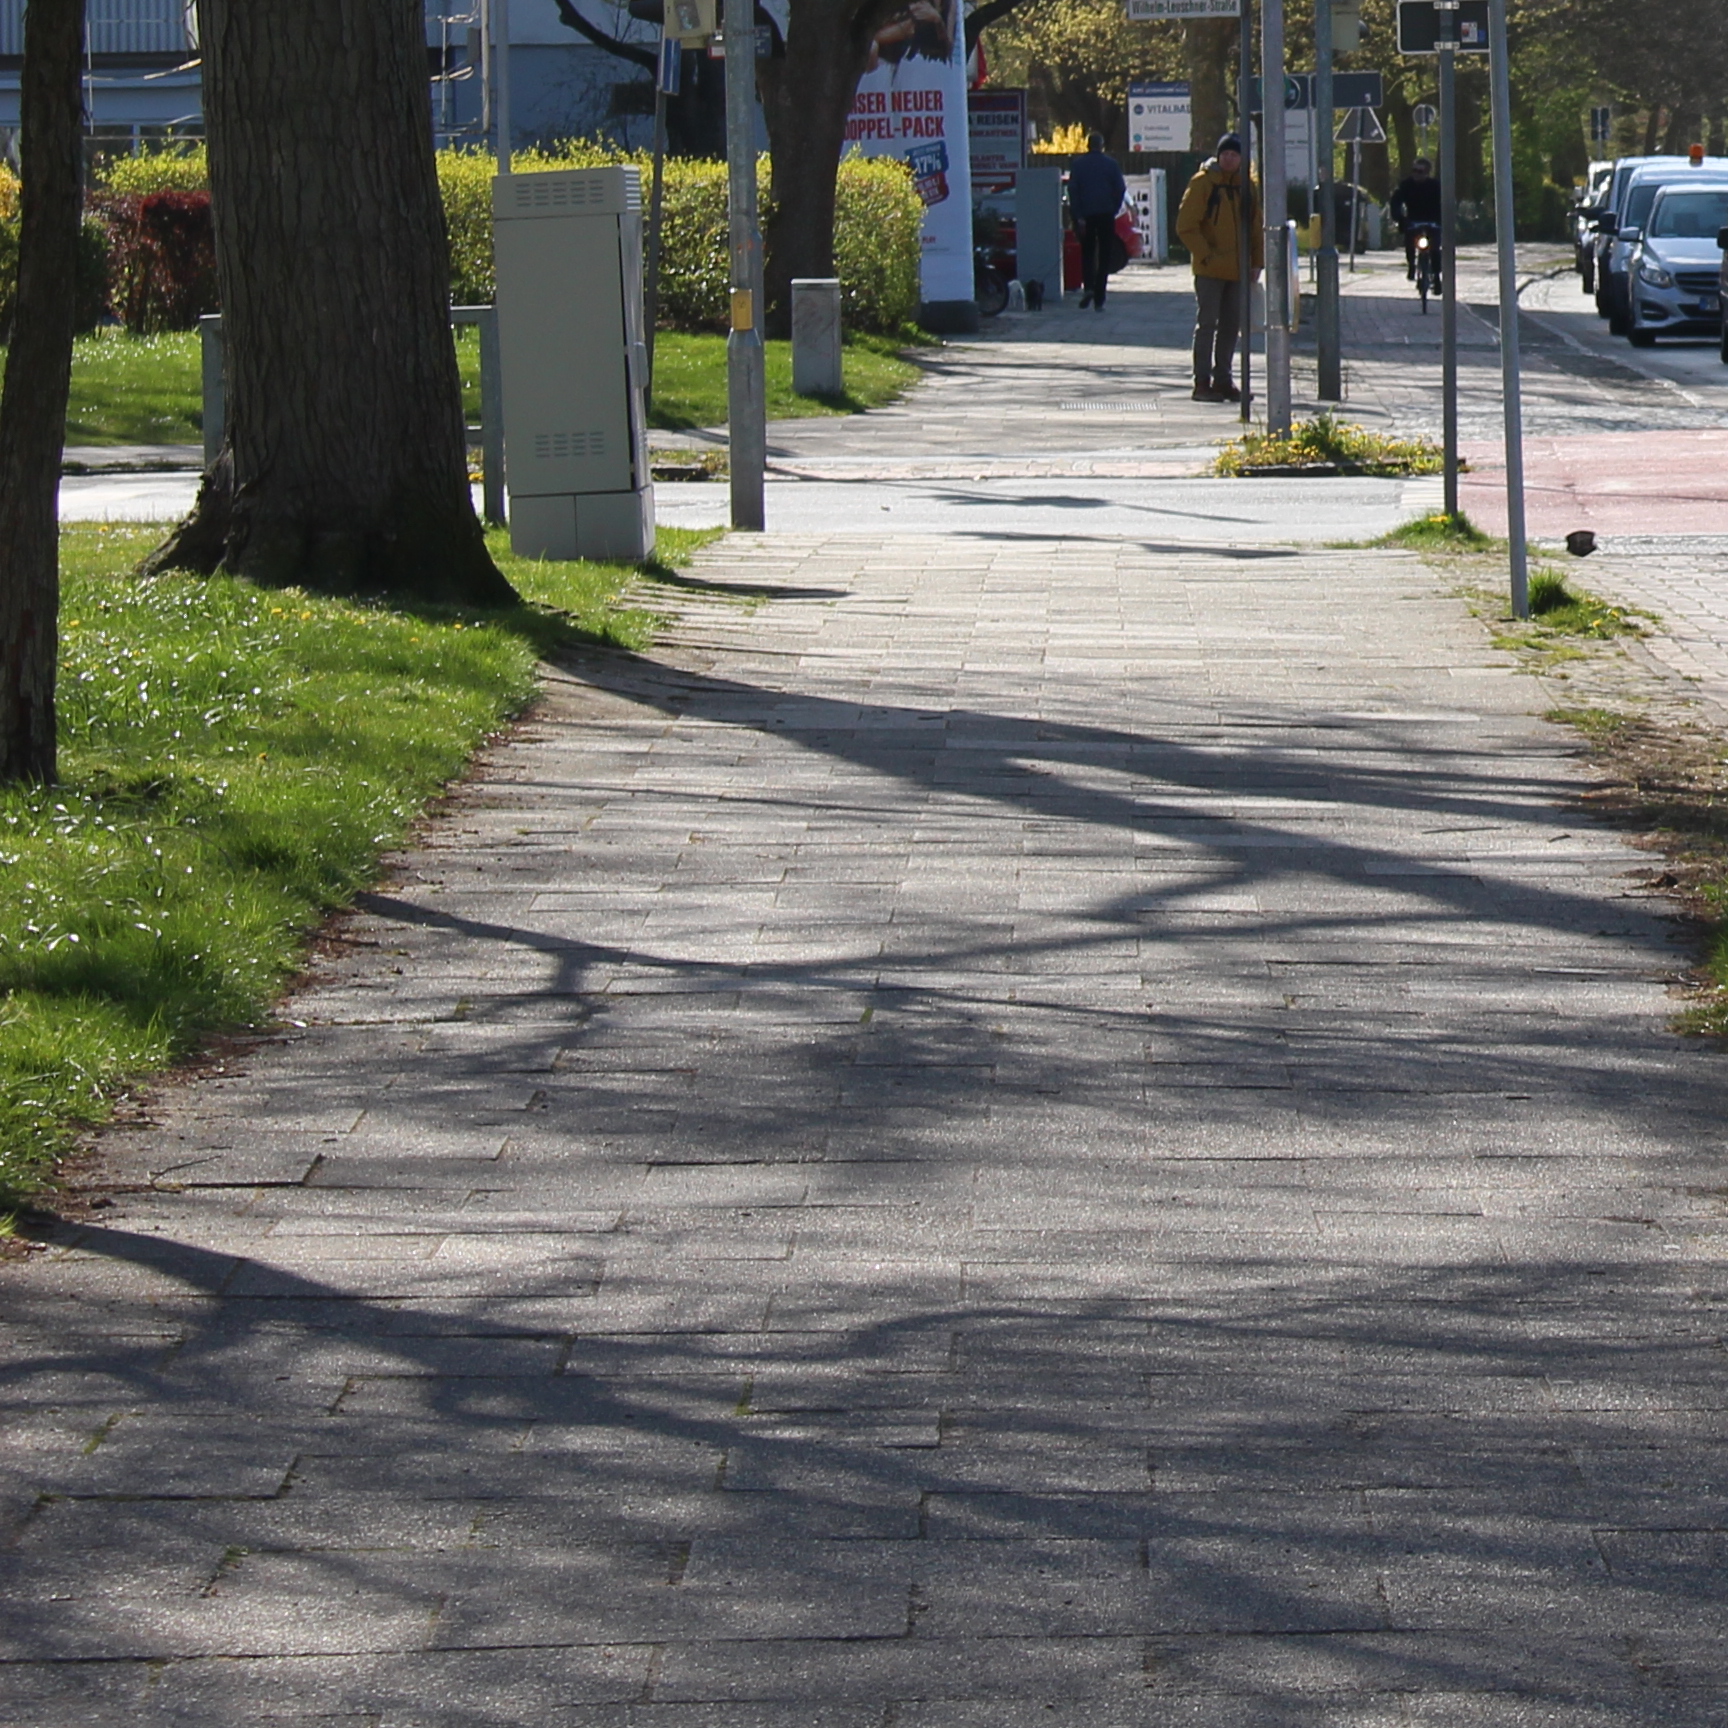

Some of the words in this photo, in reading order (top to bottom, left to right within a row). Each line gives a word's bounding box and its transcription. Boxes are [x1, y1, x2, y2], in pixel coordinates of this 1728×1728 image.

[1132, 0, 1237, 14] Wilhelm-Leuschner-Straße
[891, 90, 943, 112] NEUER
[976, 114, 1019, 125] REISEN
